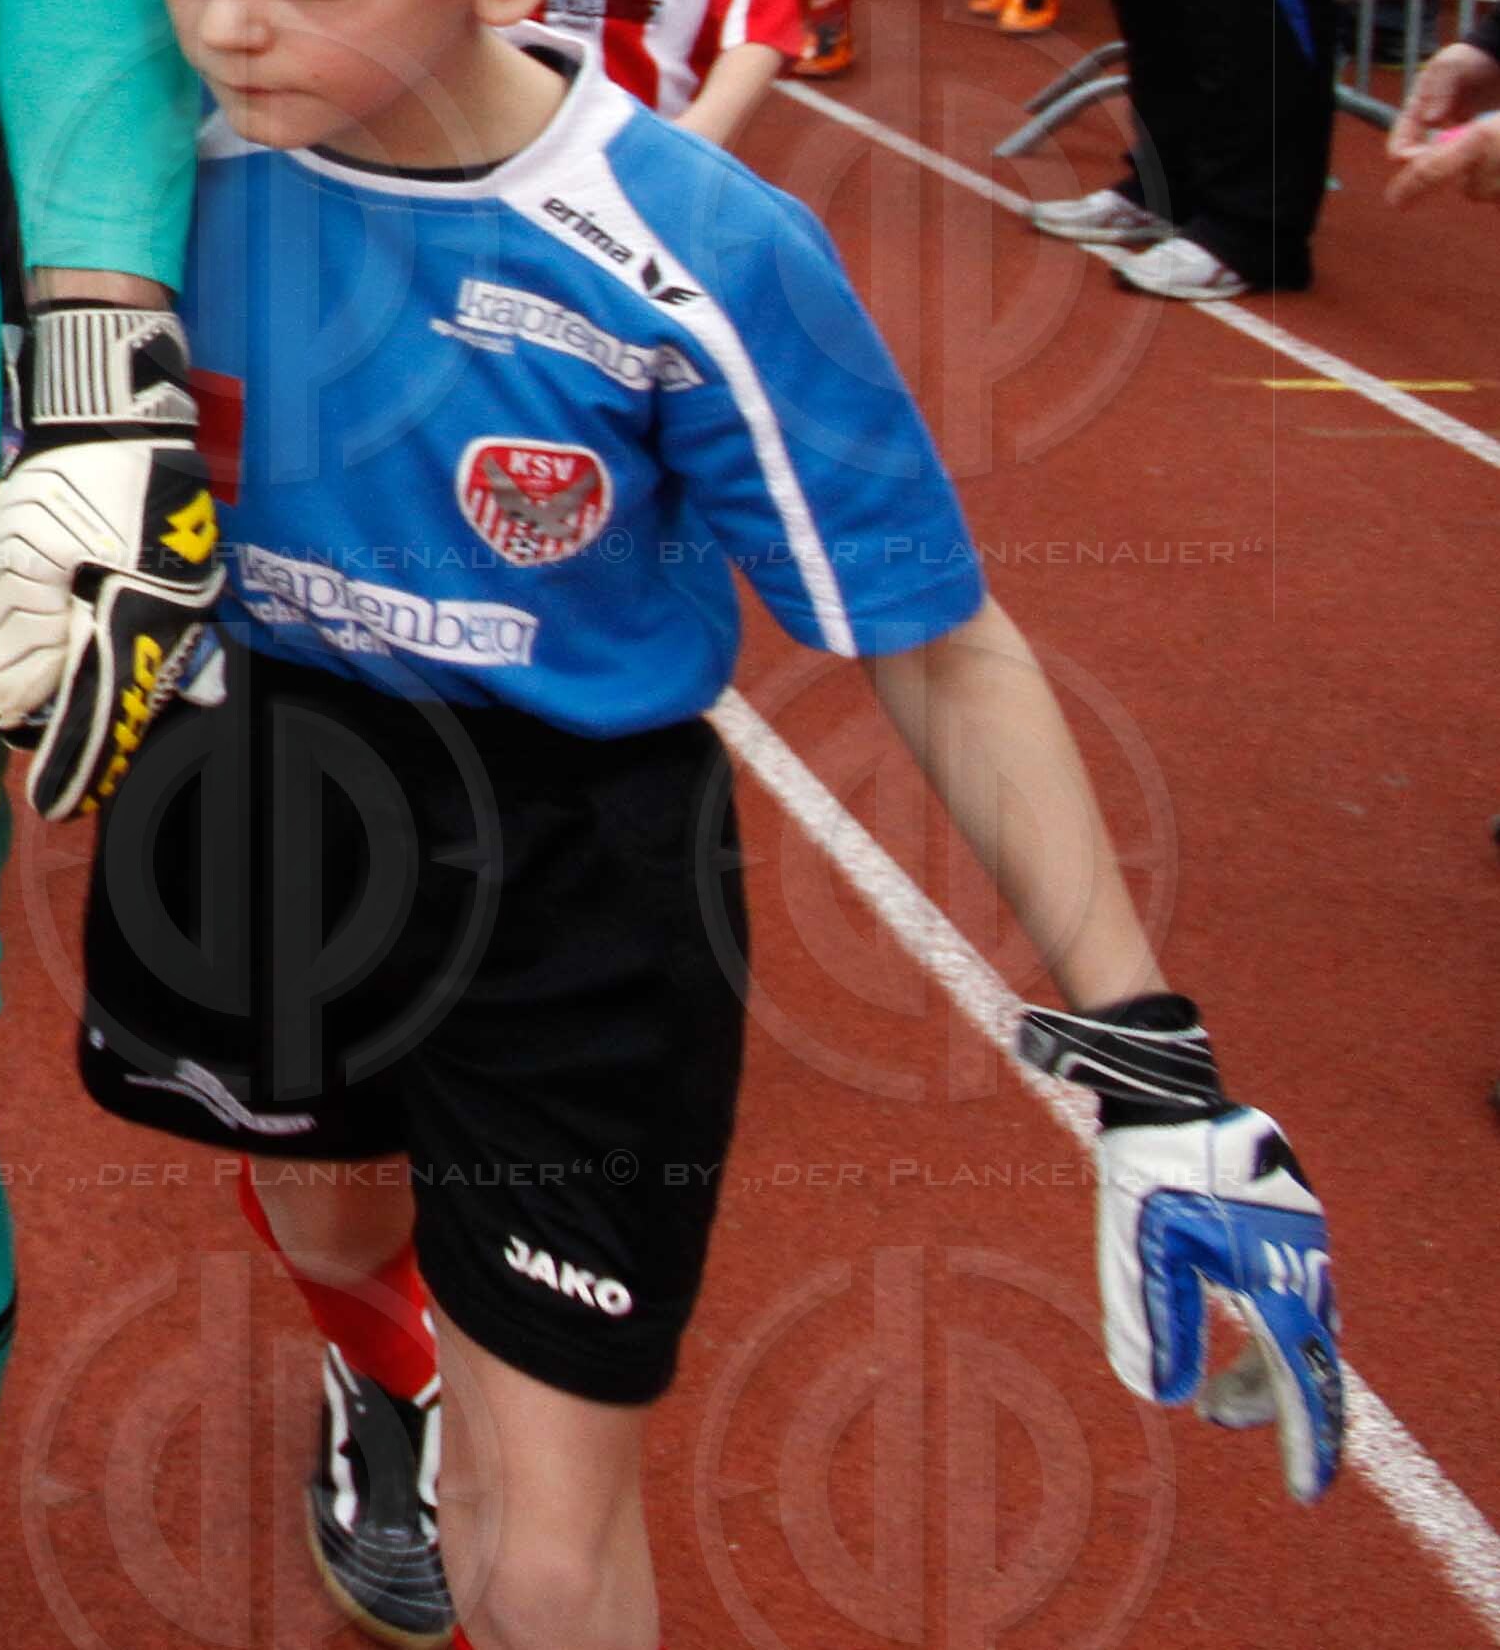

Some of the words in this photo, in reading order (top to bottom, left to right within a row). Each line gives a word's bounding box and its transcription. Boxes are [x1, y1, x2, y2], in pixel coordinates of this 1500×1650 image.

[543, 198, 635, 265] erima
[508, 451, 577, 482] KSV
[503, 1235, 632, 1315] JAKO
